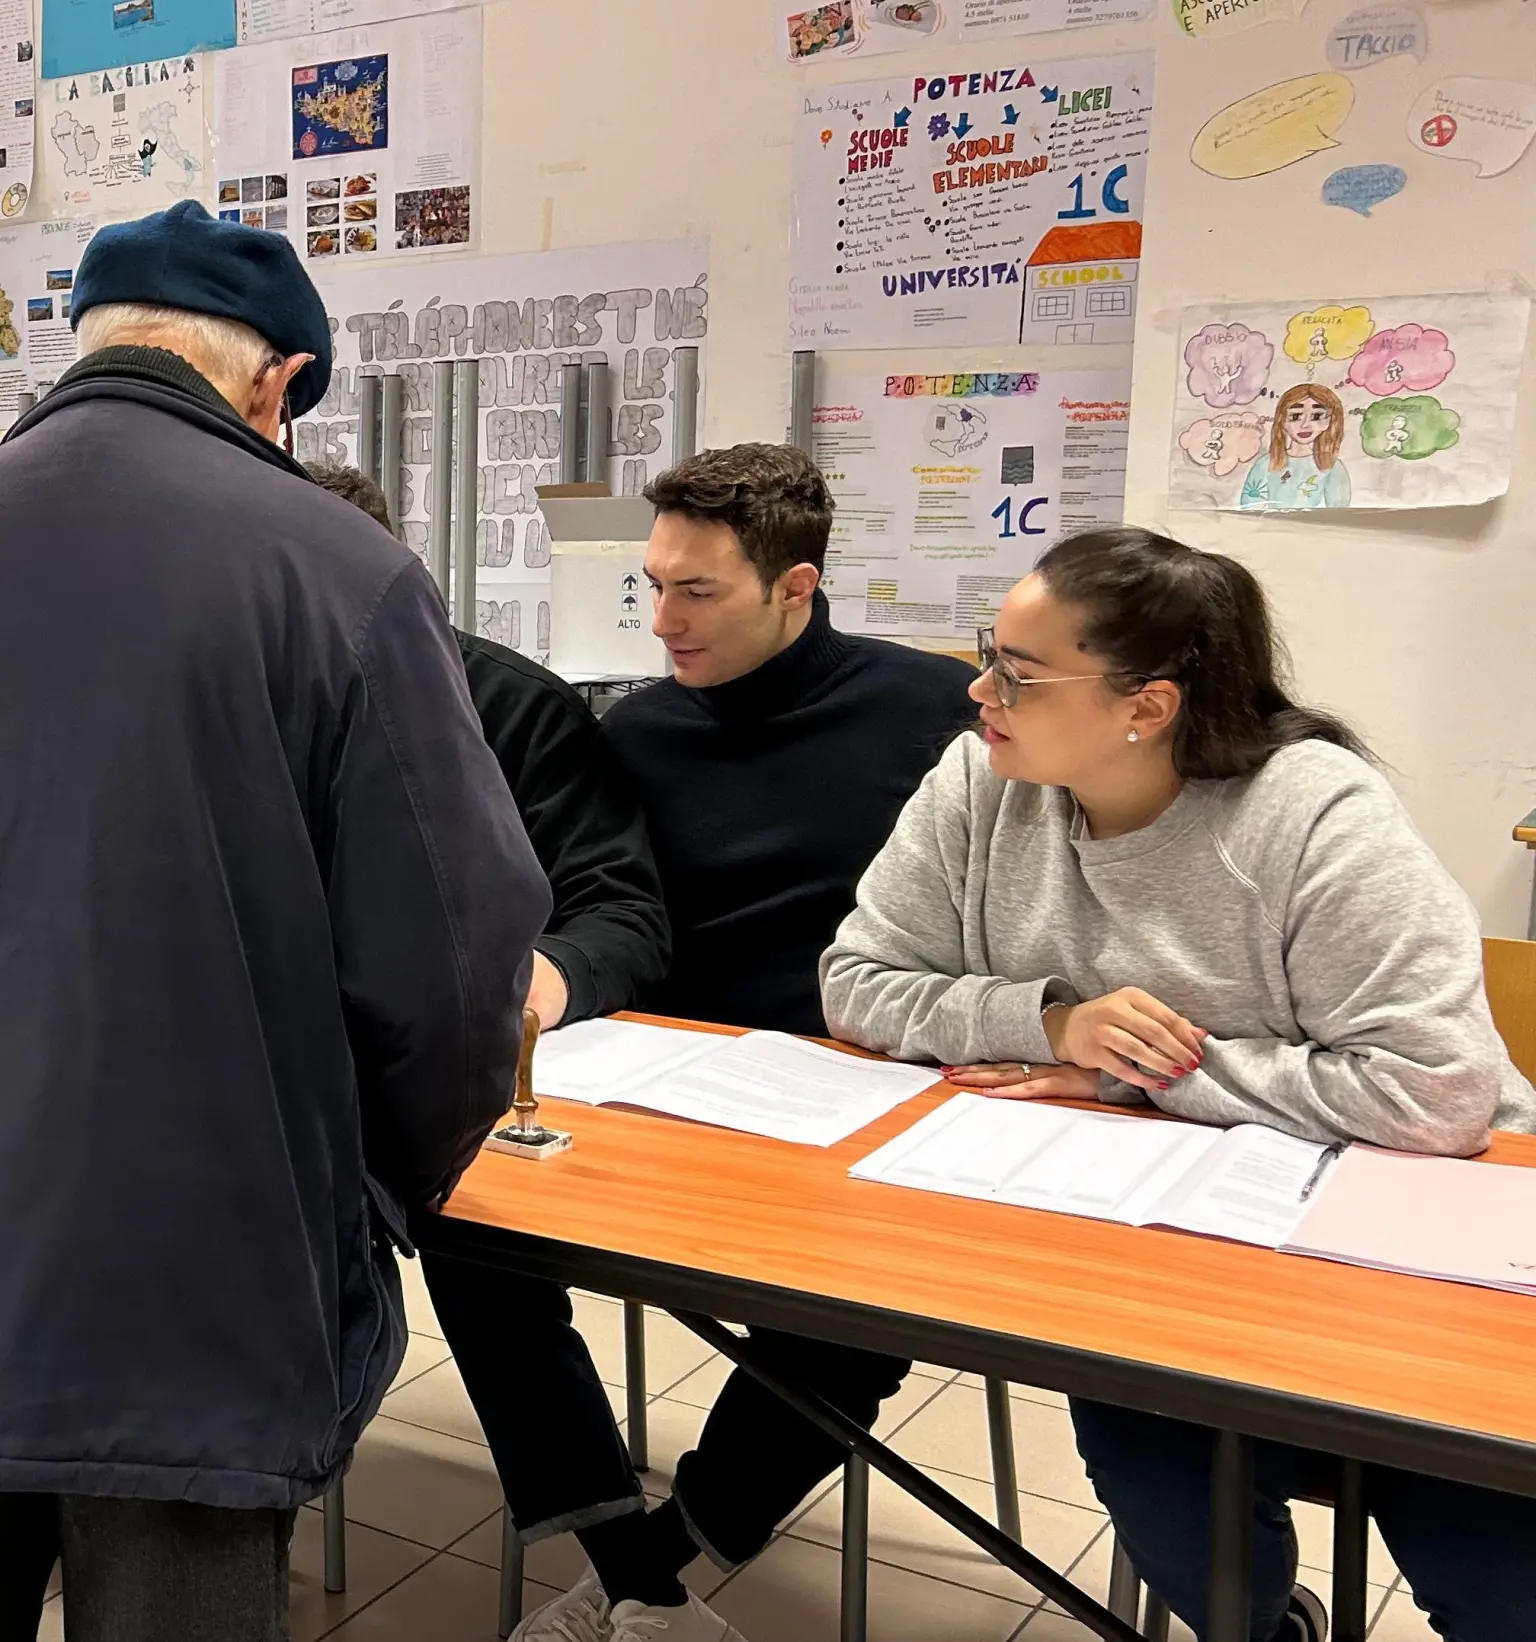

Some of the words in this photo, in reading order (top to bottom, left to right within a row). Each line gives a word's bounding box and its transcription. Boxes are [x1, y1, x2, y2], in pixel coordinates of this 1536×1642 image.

[1184, 16, 1194, 31] E
[913, 67, 1036, 103] POTENZA
[1058, 86, 1112, 116] LICEI
[847, 128, 909, 156] SCUOLE
[946, 133, 1015, 165] SCUOLE
[1038, 264, 1126, 289] SCHOOL
[991, 496, 1049, 538] 1C
[617, 619, 641, 629] ALTO
